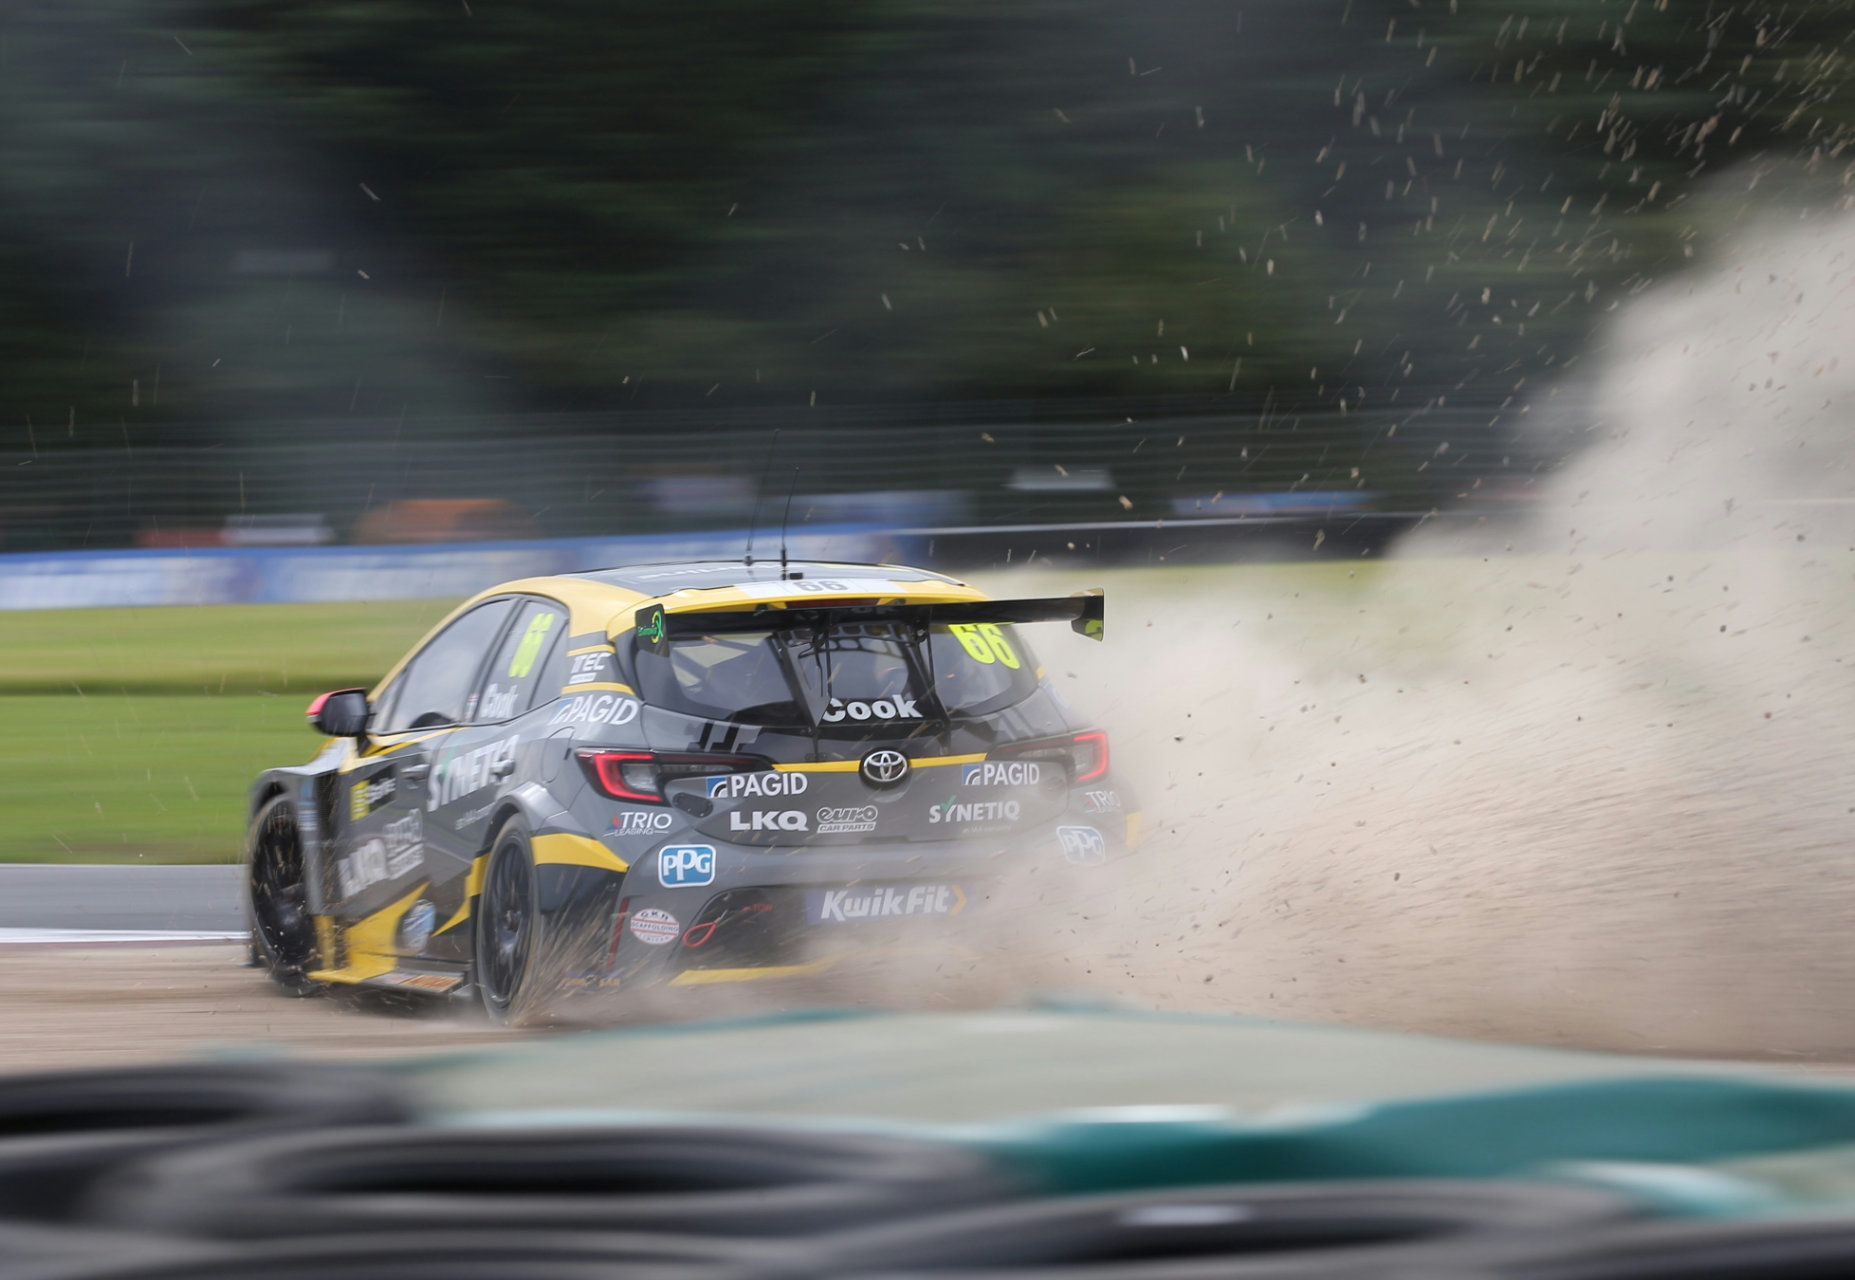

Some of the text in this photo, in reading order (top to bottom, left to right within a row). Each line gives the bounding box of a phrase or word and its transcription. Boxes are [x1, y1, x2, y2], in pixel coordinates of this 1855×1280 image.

[793, 580, 849, 592] 66
[948, 622, 1020, 671] 66
[570, 652, 613, 674] TEC
[562, 694, 639, 725] PAGID
[821, 694, 923, 723] Cook
[730, 772, 808, 798] PAGID
[982, 763, 1041, 786] PAGID
[620, 812, 673, 830] TRIO
[729, 810, 809, 832] LKQ
[928, 796, 1021, 824] SYNETIQ
[820, 822, 875, 833] CAR PARTS
[662, 849, 712, 882] PPG
